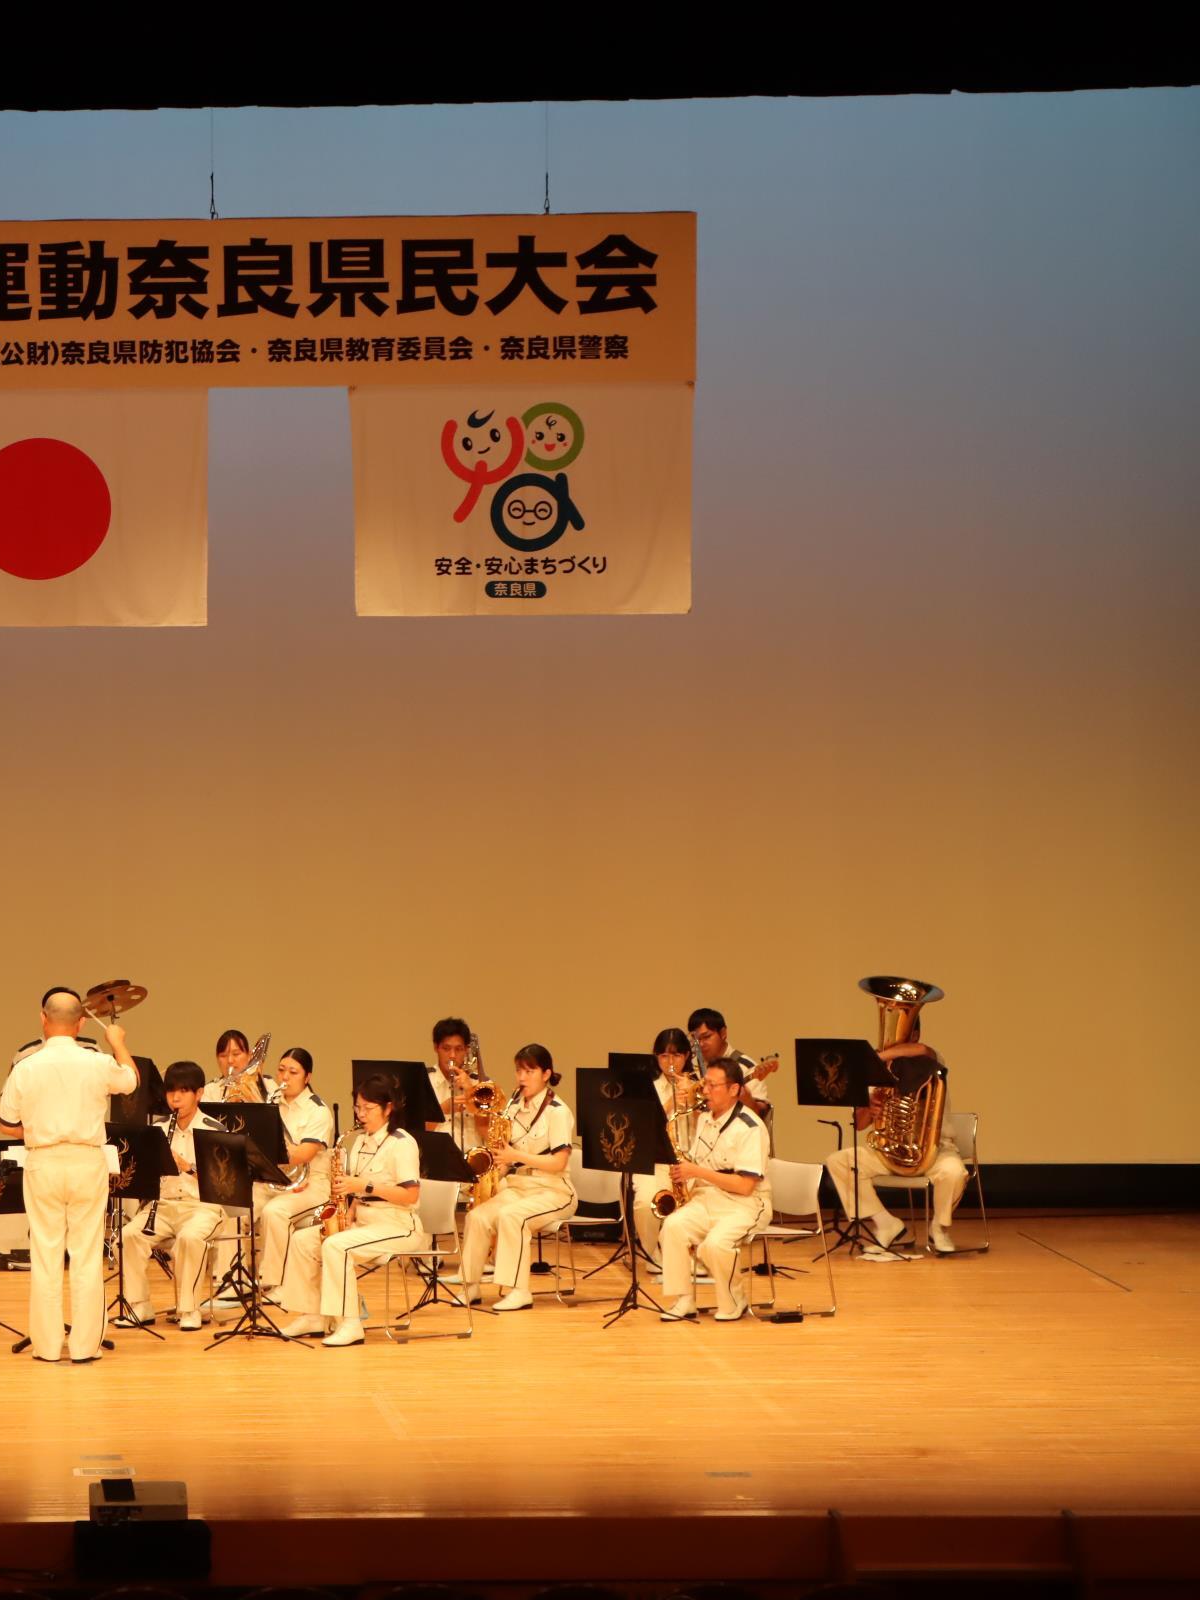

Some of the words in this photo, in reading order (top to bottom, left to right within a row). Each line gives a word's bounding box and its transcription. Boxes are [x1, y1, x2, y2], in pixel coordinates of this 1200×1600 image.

[434, 555, 607, 576] 安全・安心まちづくり
[494, 582, 537, 597] 奈良県
